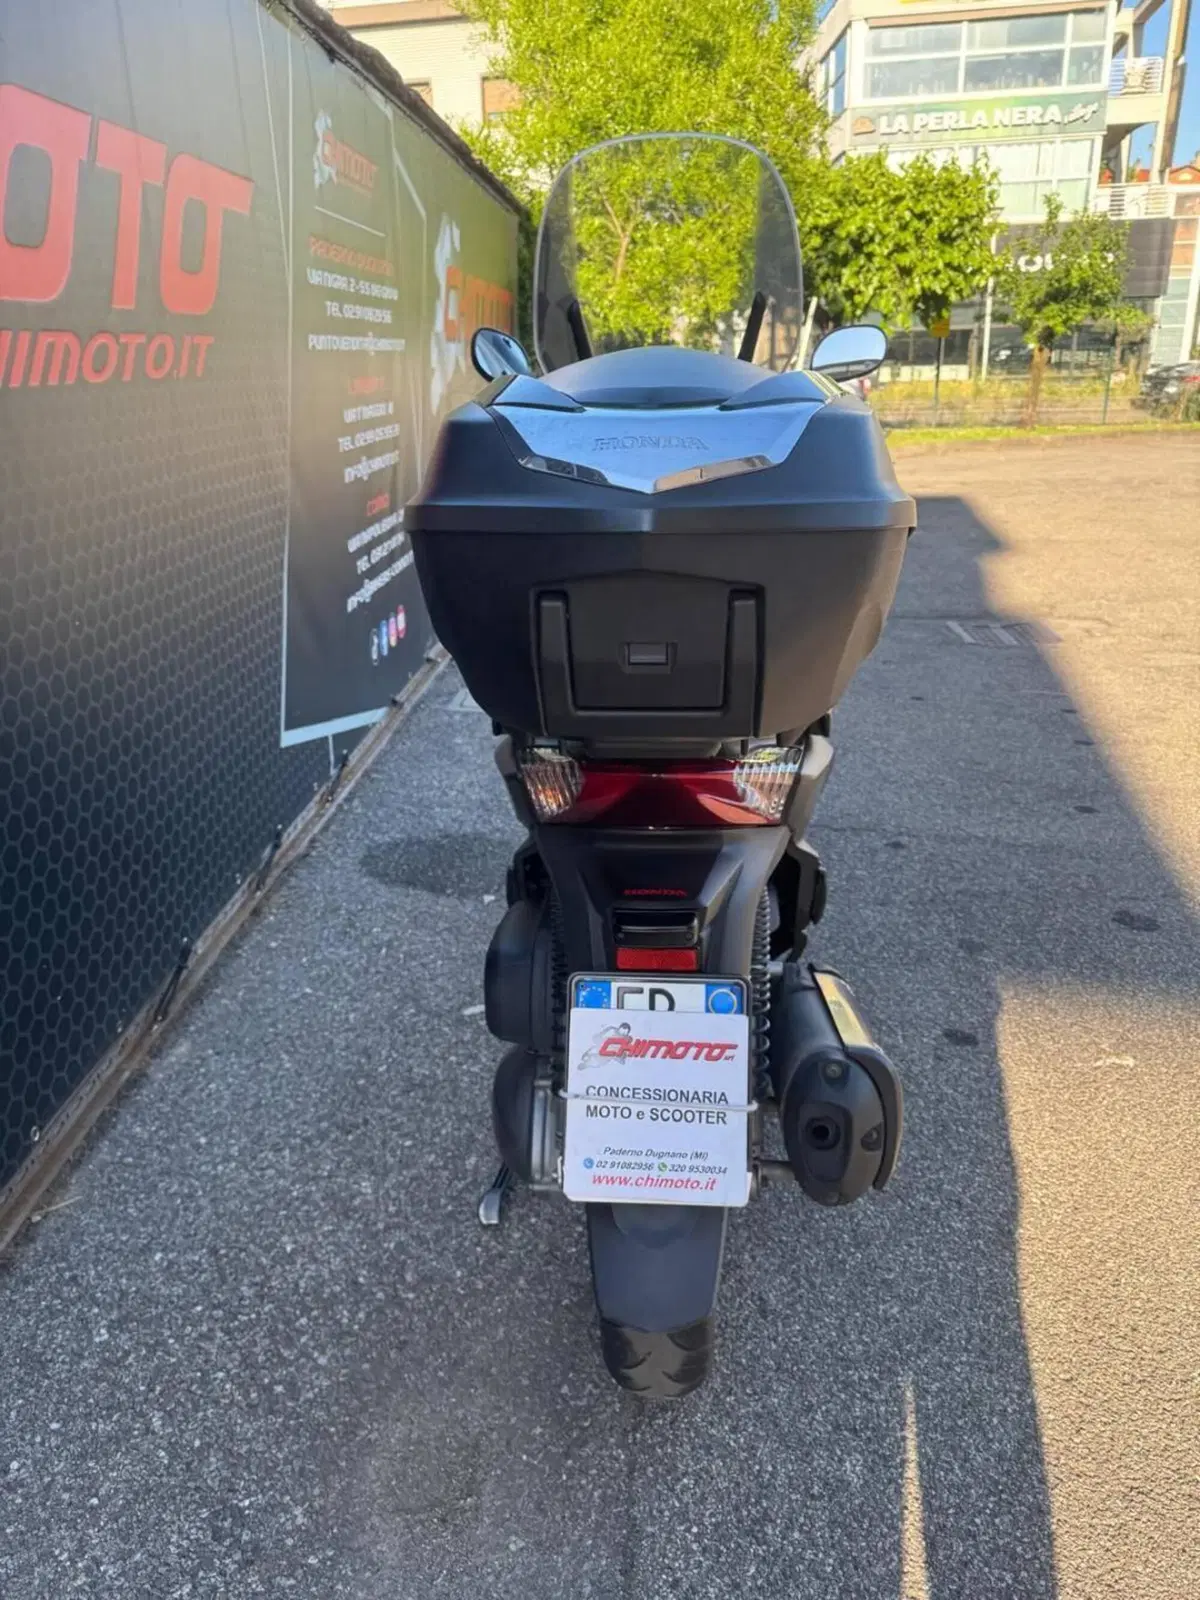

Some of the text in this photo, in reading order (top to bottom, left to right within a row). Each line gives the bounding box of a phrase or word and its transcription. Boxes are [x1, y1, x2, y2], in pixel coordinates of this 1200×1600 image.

[879, 115, 910, 135] LA
[913, 109, 989, 132] PERLA
[993, 105, 1062, 127] NERA
[592, 435, 712, 452] HONDA
[623, 887, 688, 897] HONDA
[598, 1036, 739, 1062] CHIMOTO
[586, 1085, 729, 1106] CONCESSIONARIA
[585, 1104, 728, 1126] MOTO e SCOOTER
[603, 1146, 709, 1161] Paderno Dugnano (MI)
[595, 1160, 728, 1175] 02 91082956 320 9530034
[592, 1173, 717, 1191] www.chimoto.it
